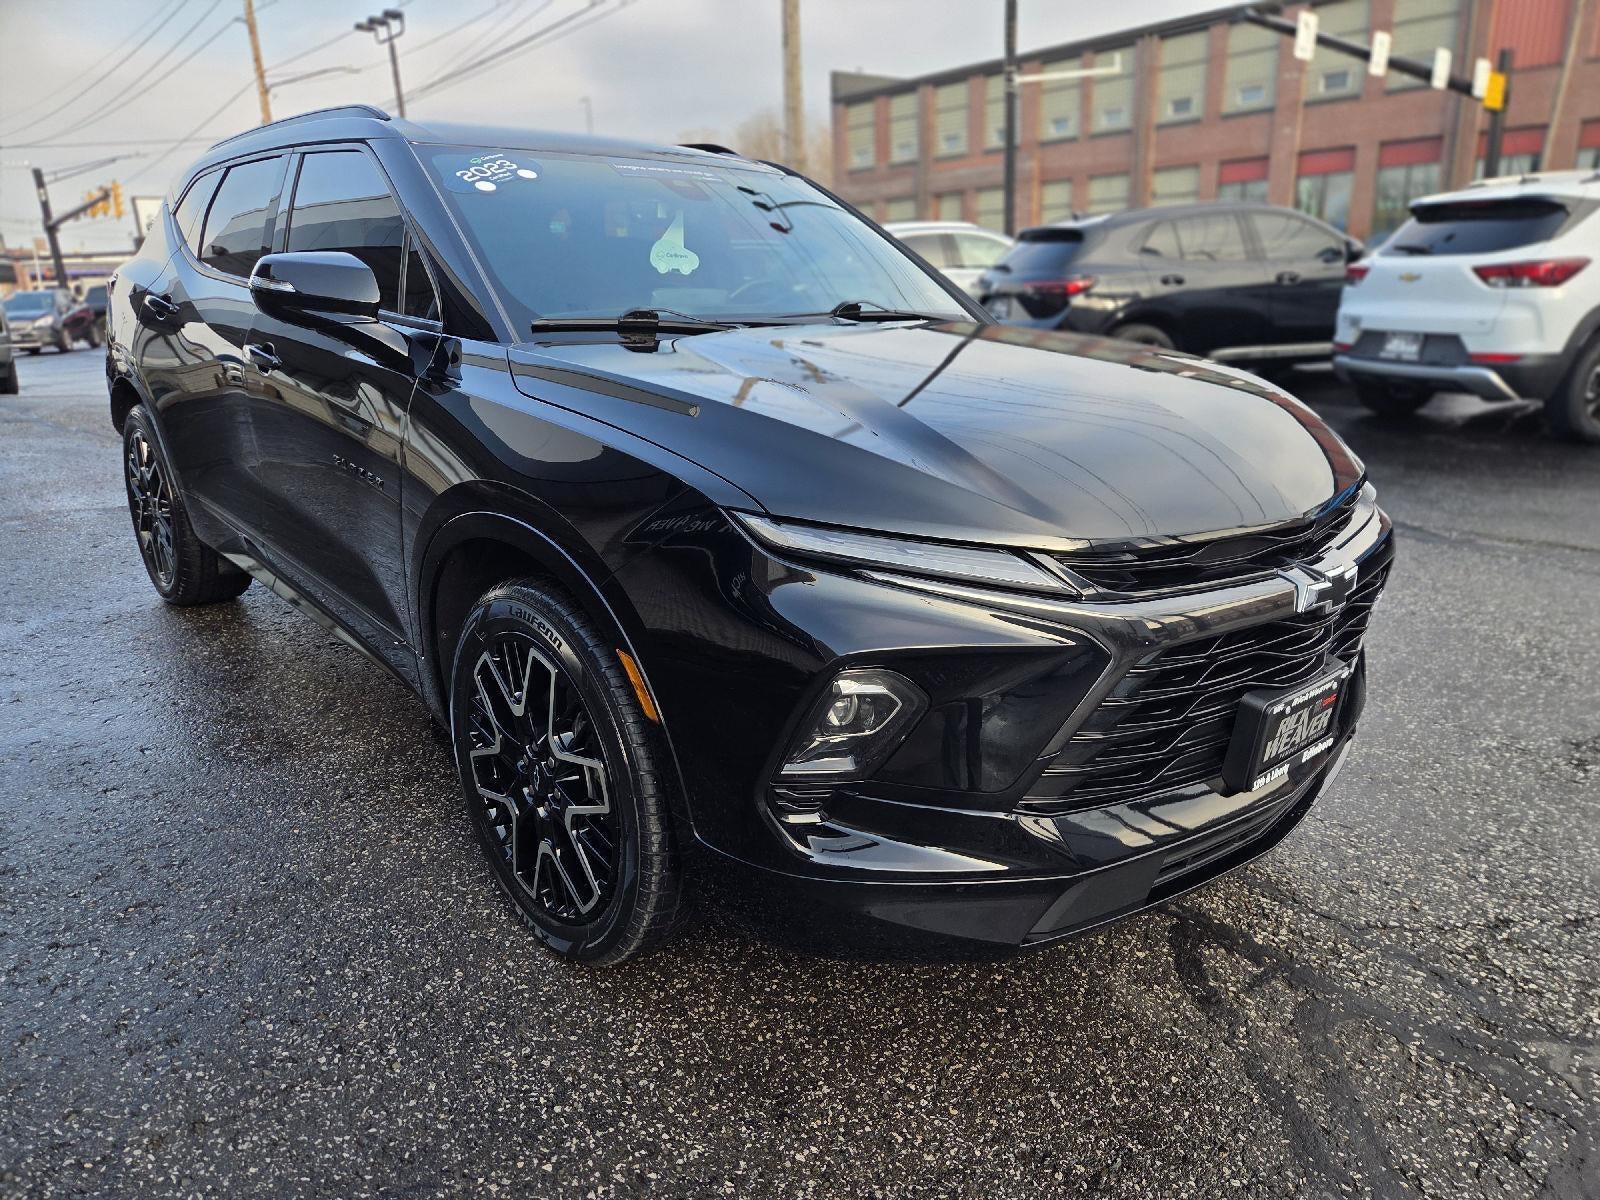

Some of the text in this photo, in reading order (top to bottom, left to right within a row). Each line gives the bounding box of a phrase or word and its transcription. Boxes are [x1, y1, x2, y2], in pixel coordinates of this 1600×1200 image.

[455, 159, 518, 182] 2023
[1263, 707, 1333, 763] WEAVER
[1276, 704, 1314, 740] RICK
